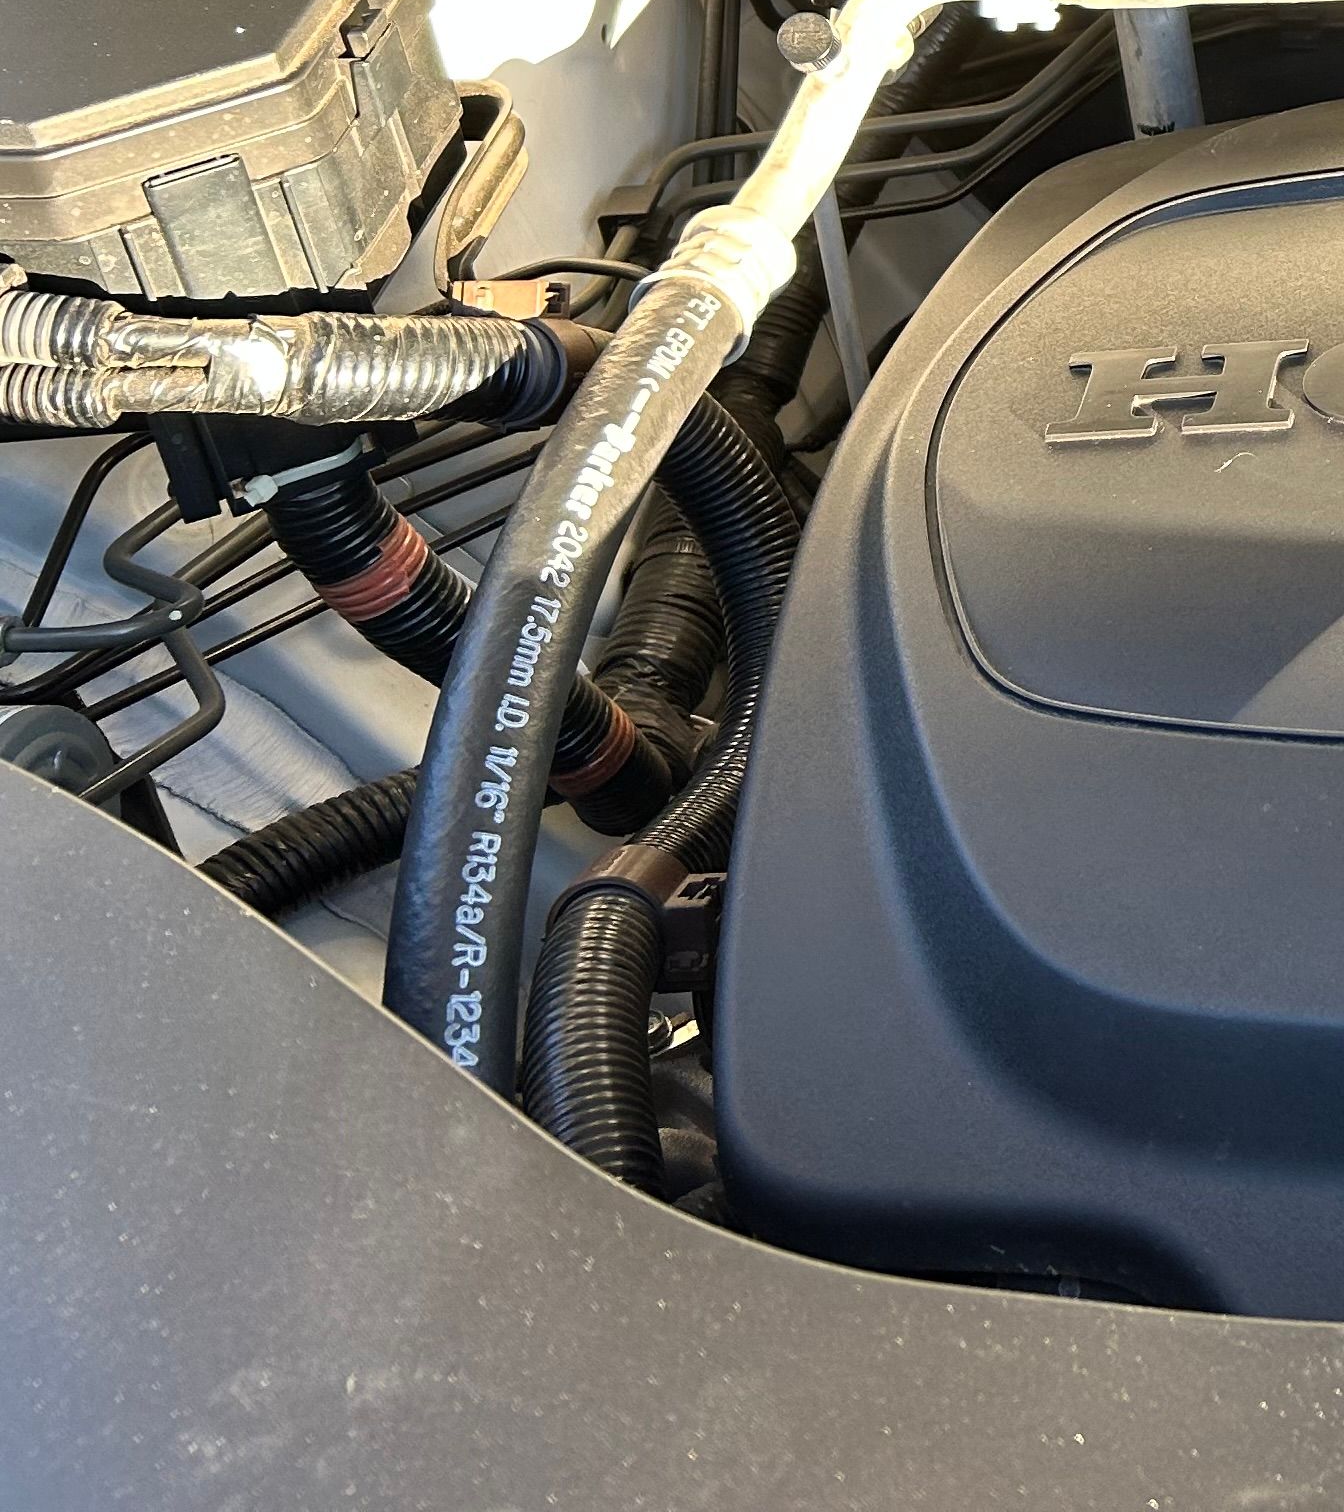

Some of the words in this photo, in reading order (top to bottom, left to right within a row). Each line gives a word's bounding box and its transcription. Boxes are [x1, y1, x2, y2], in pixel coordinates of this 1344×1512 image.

[565, 422, 637, 521] Parker
[540, 520, 589, 588] 2042
[507, 596, 562, 687] 17.5mm
